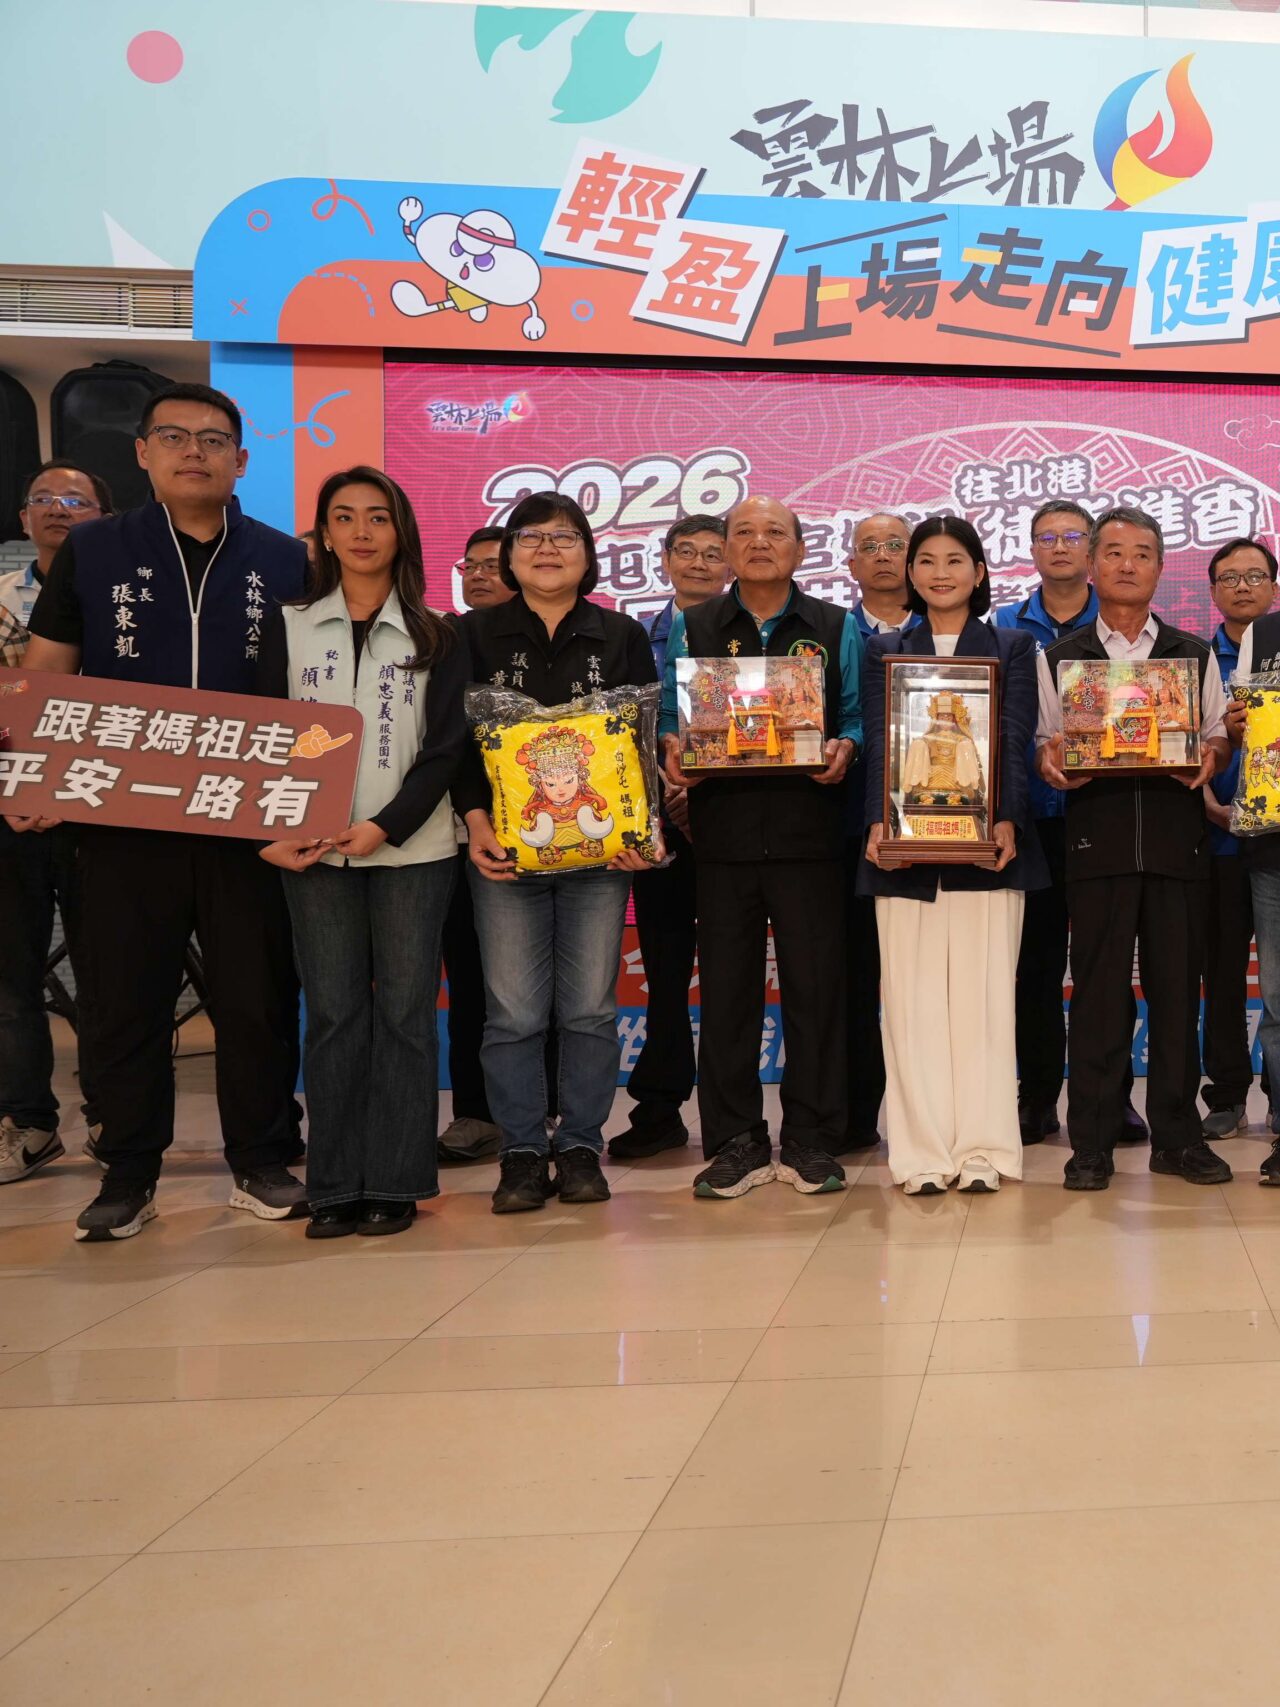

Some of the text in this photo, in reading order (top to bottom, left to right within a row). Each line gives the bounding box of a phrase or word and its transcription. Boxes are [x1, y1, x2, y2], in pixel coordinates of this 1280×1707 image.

[730, 99, 1086, 205] 雲林上場
[484, 450, 747, 536] 2026
[960, 458, 1089, 504] 往北港
[983, 483, 1255, 564] 徒進香
[111, 582, 140, 658] 張東凱
[137, 566, 155, 602] 鄉長
[245, 570, 267, 663] 水林鄉公所
[301, 666, 319, 703] 顏
[323, 649, 339, 681] 秘書
[511, 652, 529, 688] 議員
[33, 699, 297, 766] 跟著媽祖走
[378, 664, 396, 770] 顏忠義服務團隊
[0, 751, 319, 827] 平安一路有
